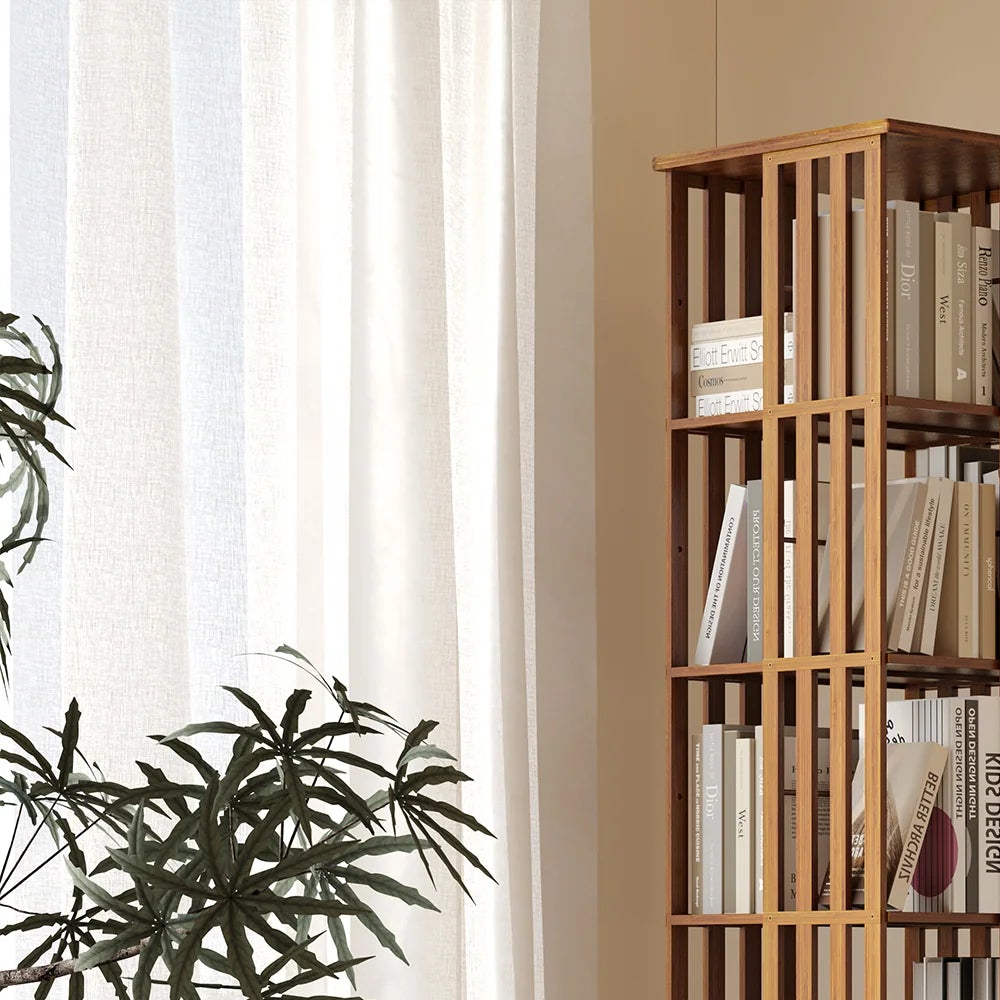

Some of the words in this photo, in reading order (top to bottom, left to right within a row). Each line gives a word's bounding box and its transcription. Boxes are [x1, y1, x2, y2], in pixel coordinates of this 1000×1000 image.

[957, 262, 967, 284] Siza
[979, 246, 992, 276] Renzo
[901, 262, 916, 299] Dior
[979, 278, 992, 306] Piano
[940, 295, 949, 324] West
[721, 342, 748, 365] Erwitt
[698, 375, 726, 388] Cosmos
[698, 397, 722, 417] Eott
[912, 520, 920, 545] GUIDE
[918, 528, 930, 570] sustainable
[924, 498, 936, 527] lifestyle
[930, 580, 938, 611] DREAM
[937, 523, 945, 552] AWAKE
[706, 784, 718, 820] Dior
[738, 810, 746, 838] West
